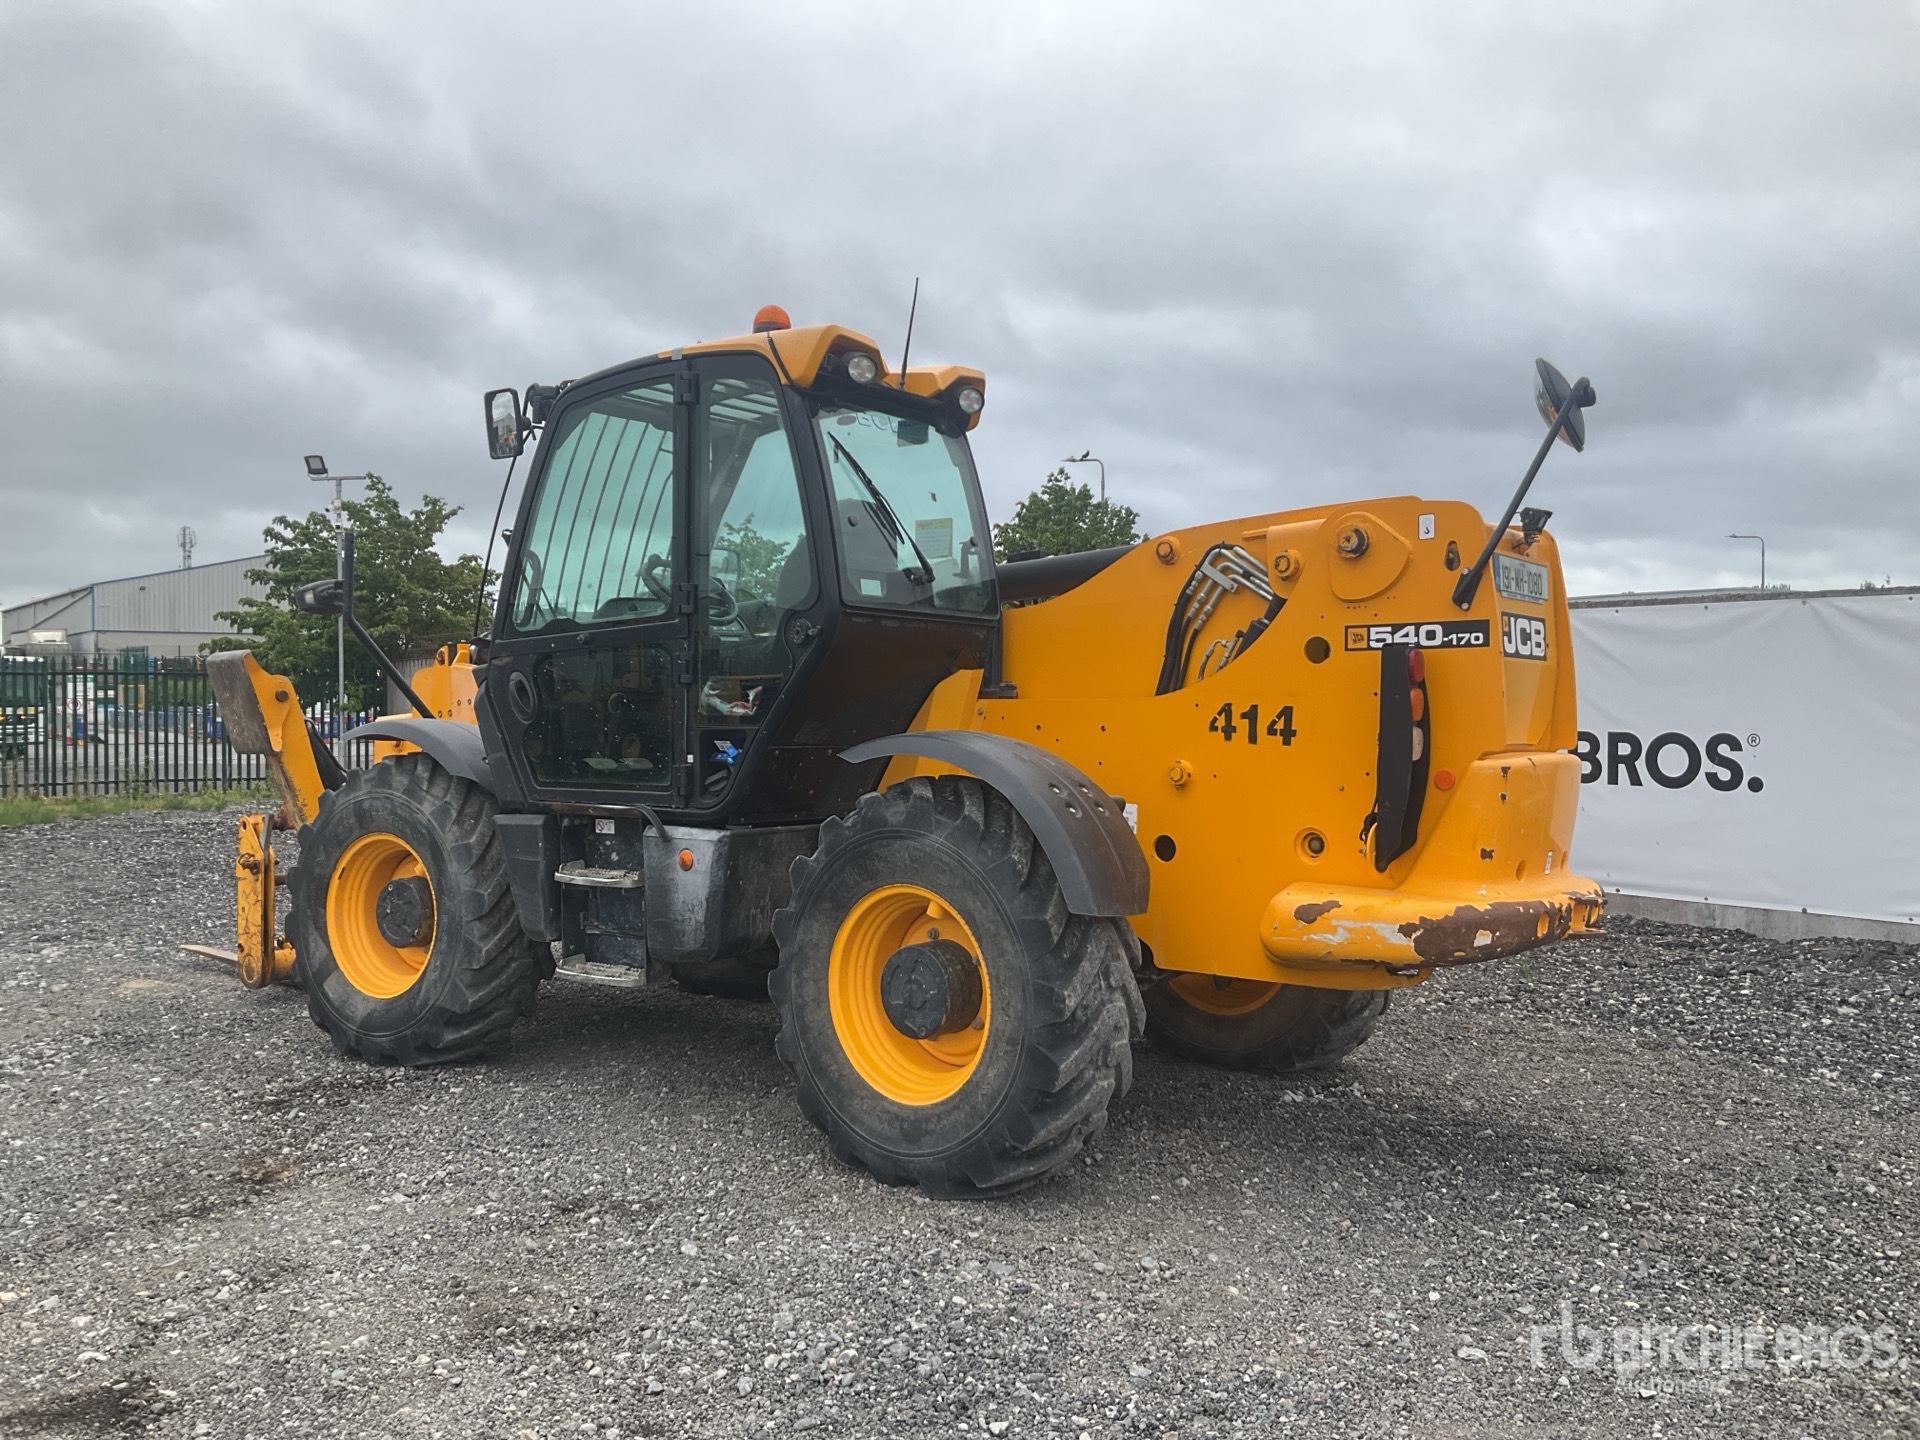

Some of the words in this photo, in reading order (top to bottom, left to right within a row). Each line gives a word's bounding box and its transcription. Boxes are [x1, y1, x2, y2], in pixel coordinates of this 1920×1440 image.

[1369, 624, 1484, 648] 540-170
[1503, 616, 1546, 657] JCB
[1208, 702, 1297, 746] 414
